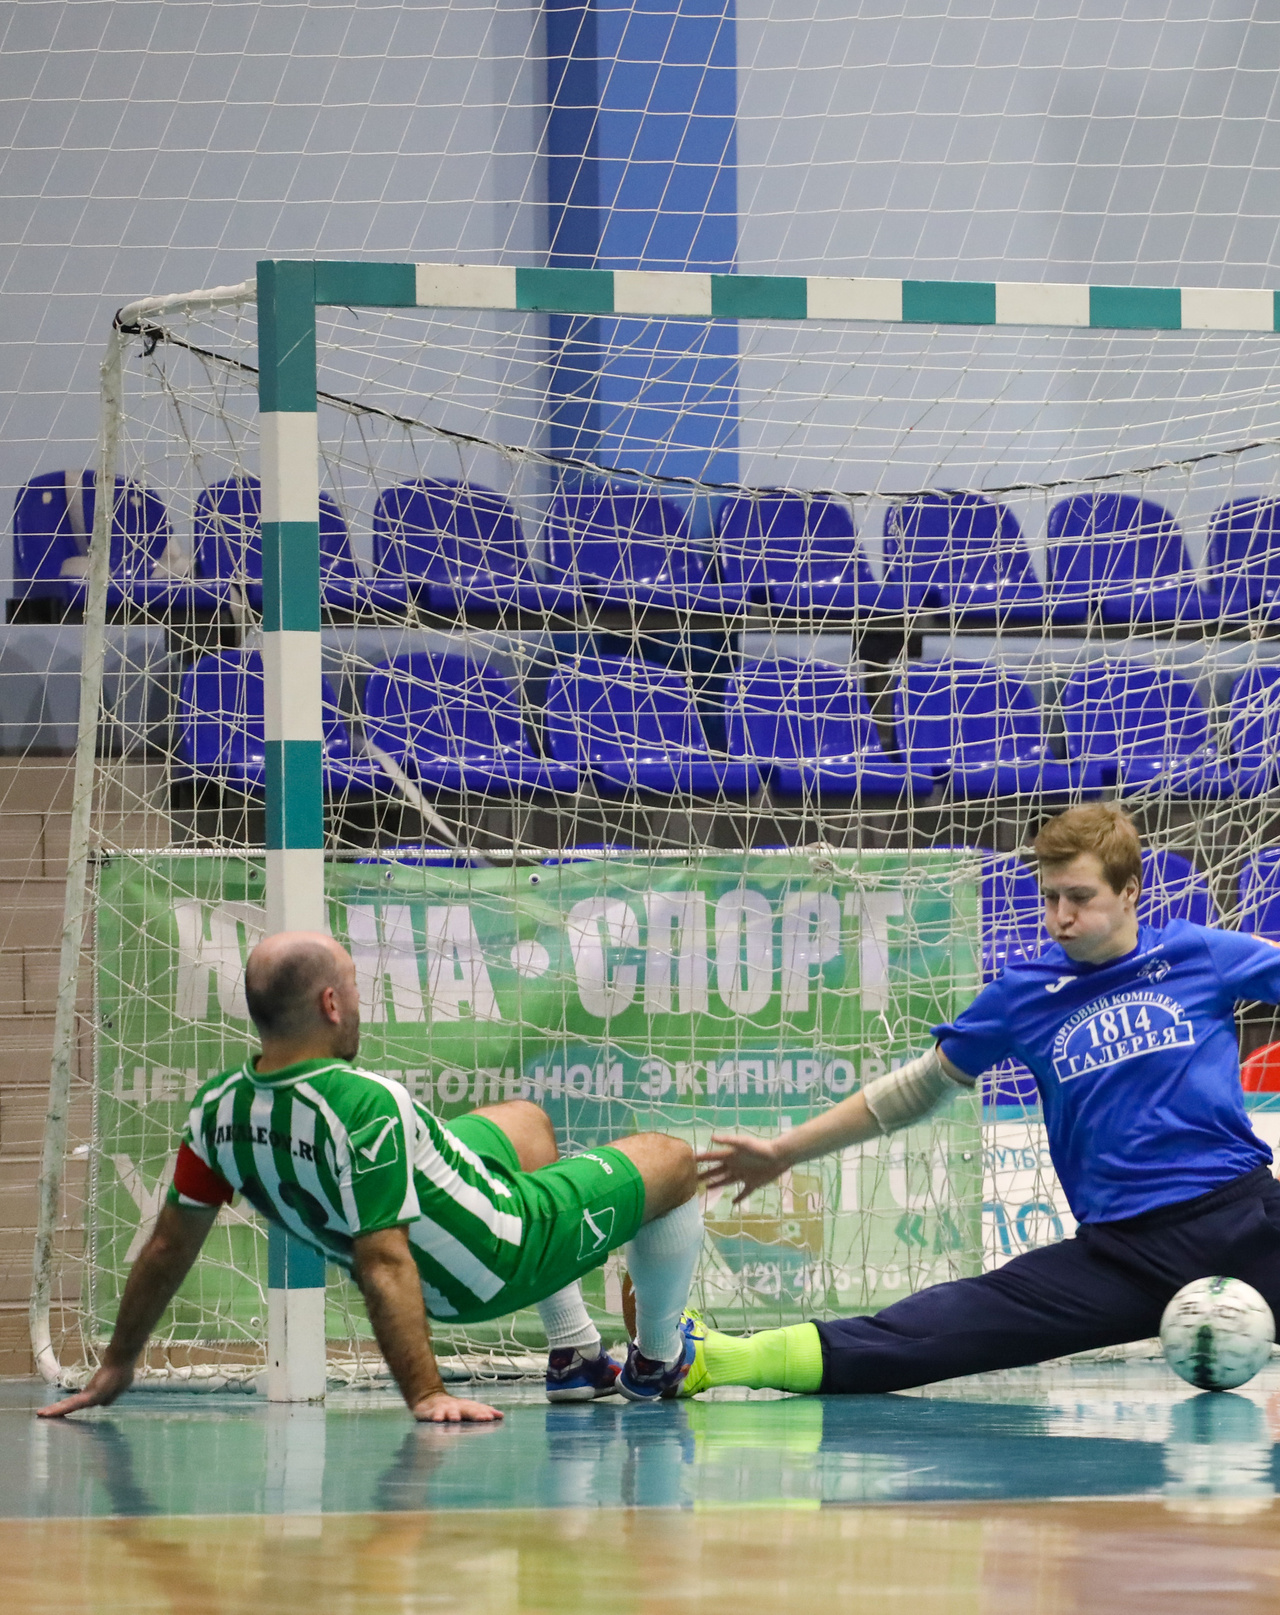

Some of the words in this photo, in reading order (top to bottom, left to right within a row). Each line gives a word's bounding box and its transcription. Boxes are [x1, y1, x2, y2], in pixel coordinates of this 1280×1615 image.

[567, 889, 903, 1018] СПОРТ
[1053, 997, 1110, 1056] ТОРГОВЫЙ
[1112, 991, 1186, 1018] КОМПЛЕКС
[1068, 1025, 1178, 1074] ГАЛЕРЕЯ
[1086, 1005, 1151, 1048] 1814
